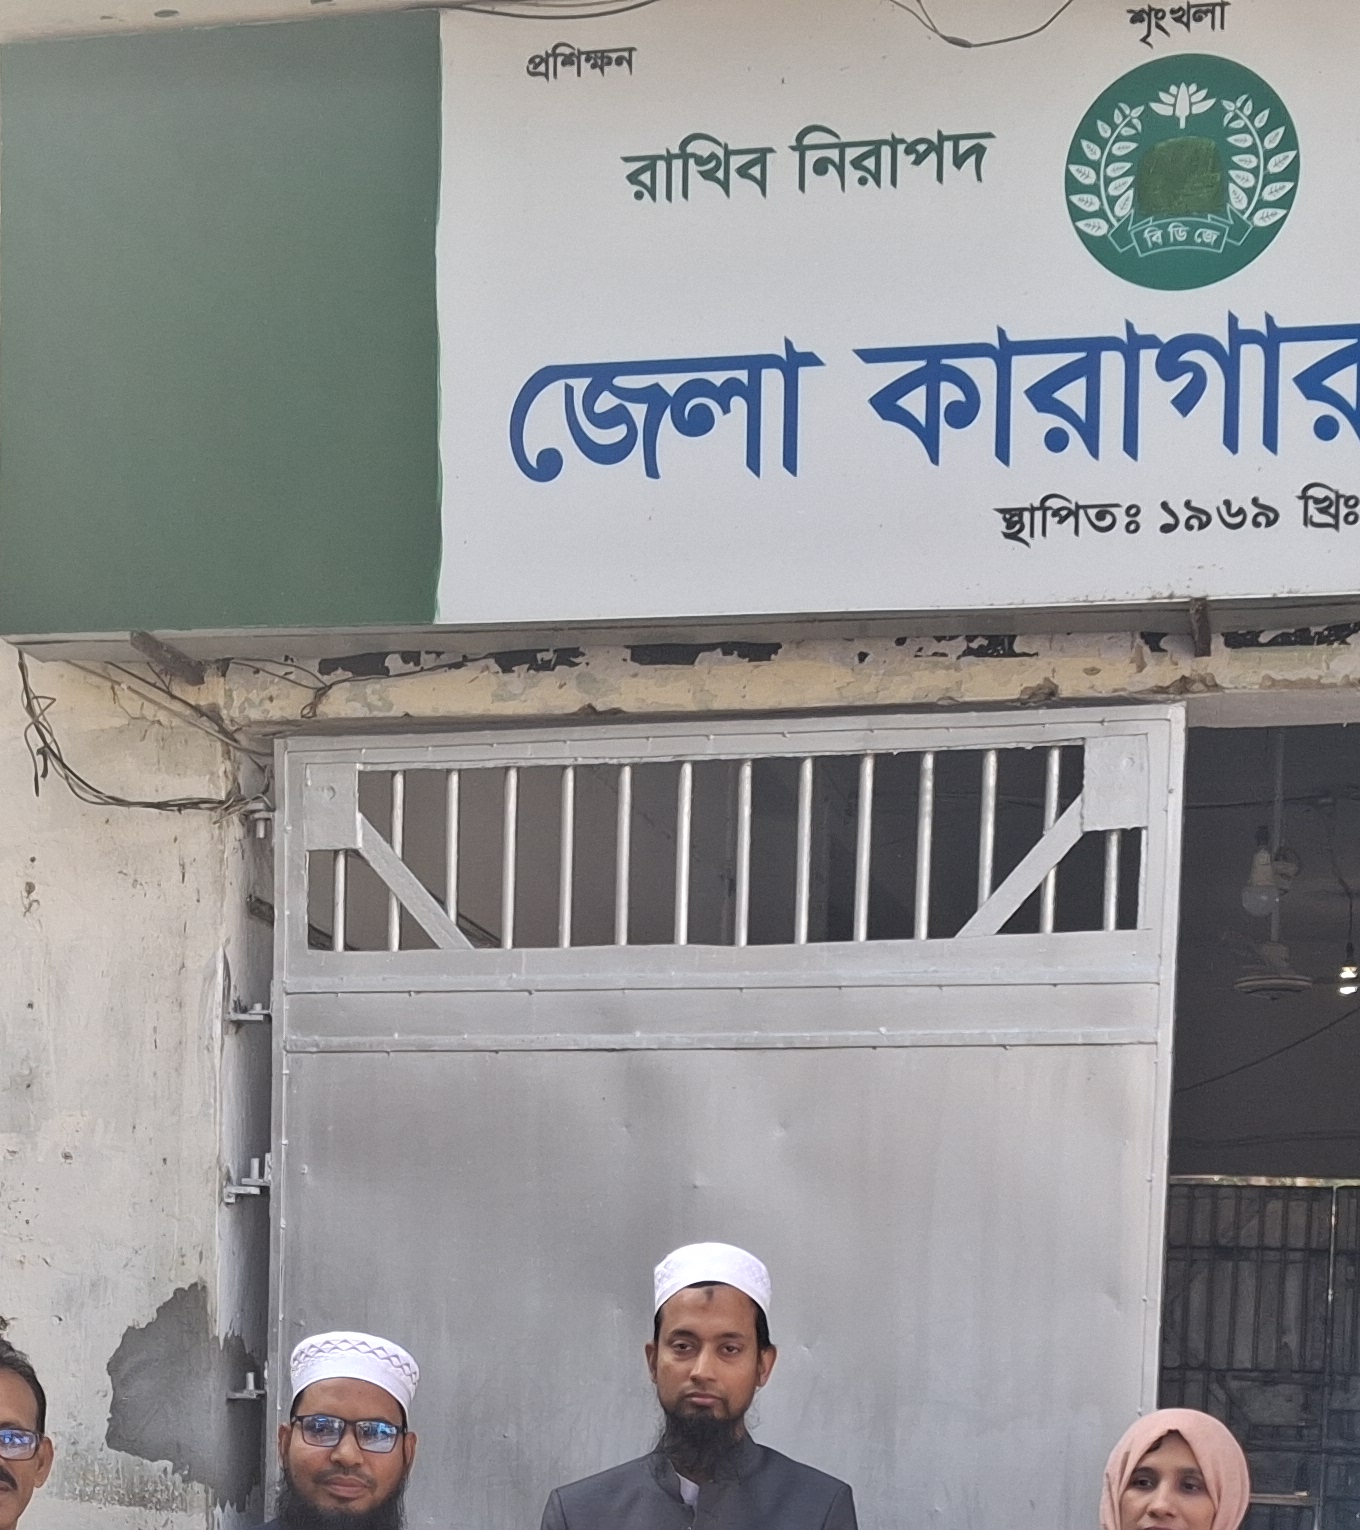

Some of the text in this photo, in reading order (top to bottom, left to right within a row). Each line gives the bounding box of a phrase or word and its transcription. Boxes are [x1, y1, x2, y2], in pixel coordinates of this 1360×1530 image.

[1126, 0, 1231, 49] শৃংখলা
[526, 41, 638, 82] প্রশিক্ষন
[621, 124, 996, 203] রাখিব নিরাপদ
[1143, 226, 1163, 249] বি
[1167, 222, 1190, 243] ডি
[509, 336, 826, 483] জেলা
[993, 481, 1360, 548] স্থাপিতঃ ১৯৬৯ খ্রিঃ
